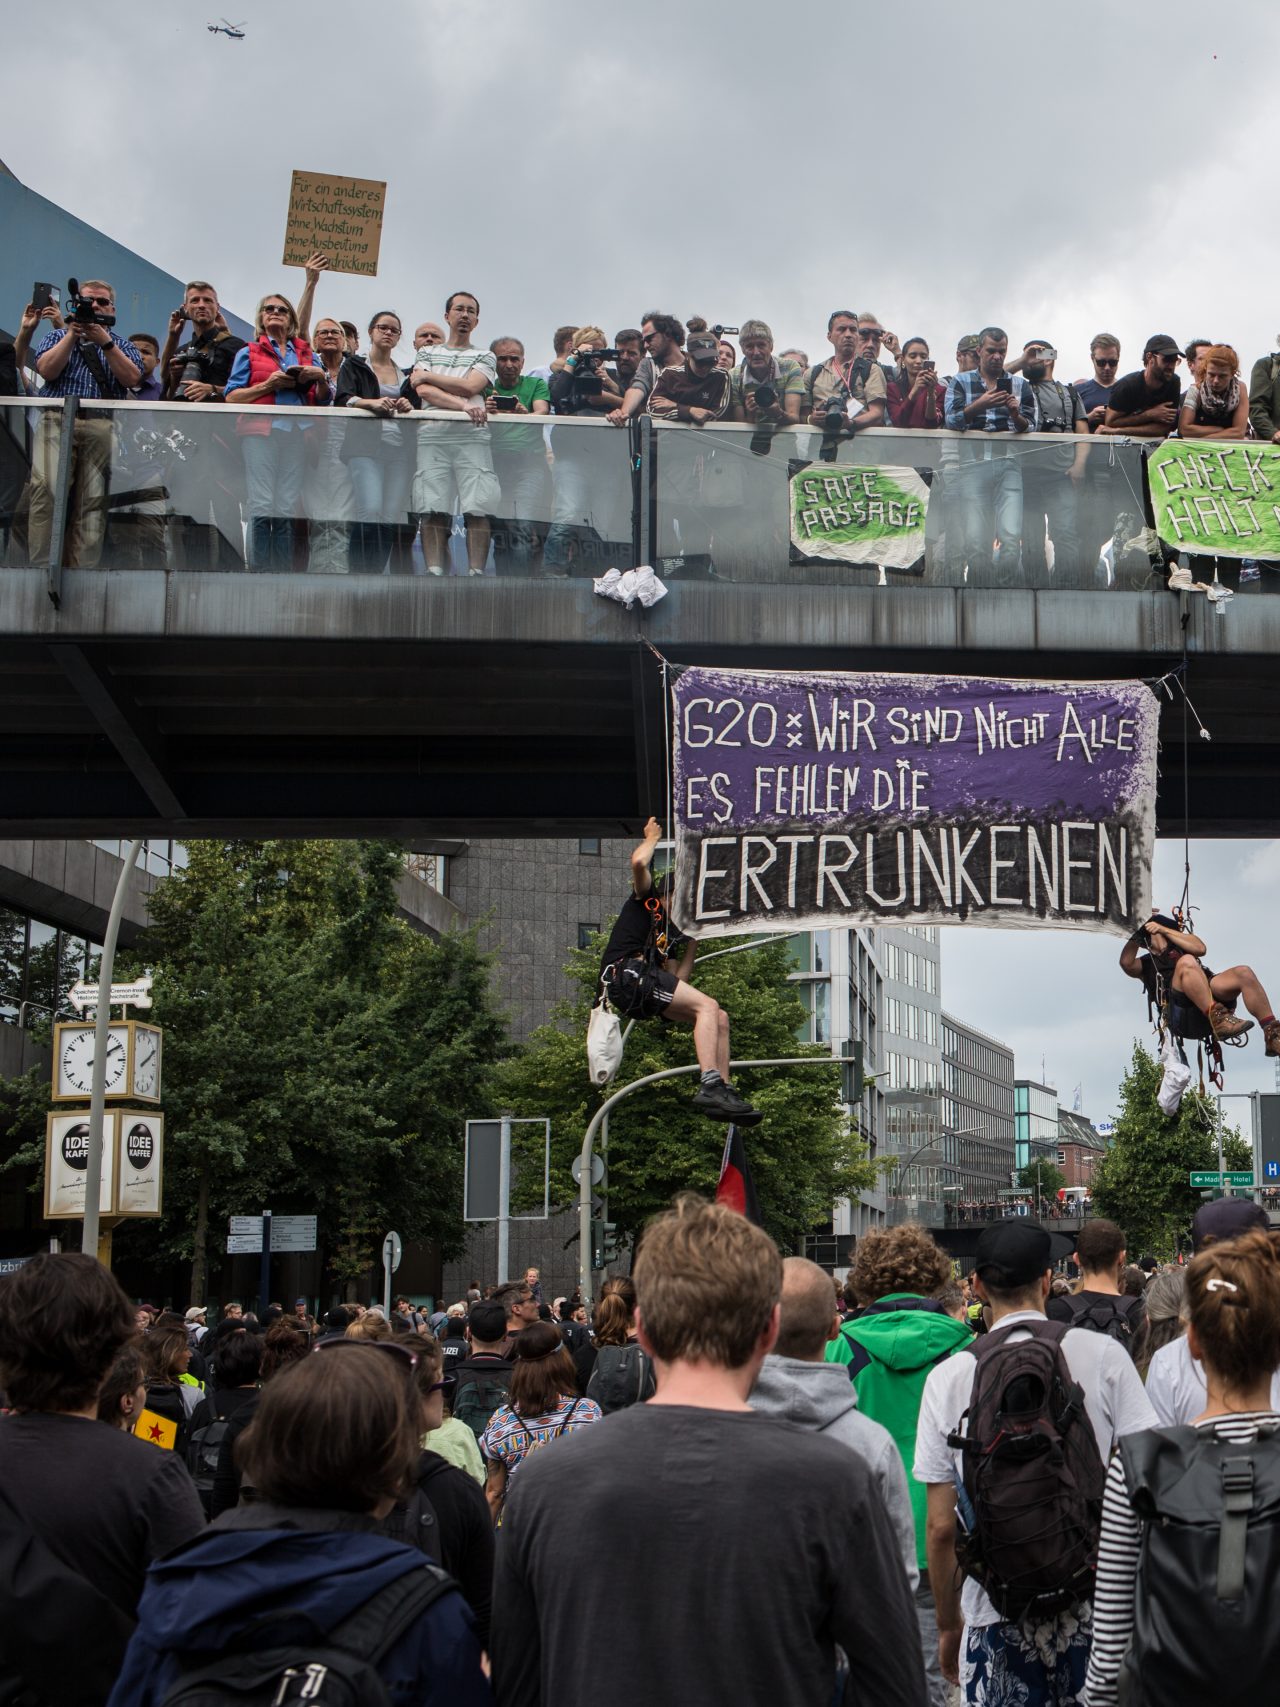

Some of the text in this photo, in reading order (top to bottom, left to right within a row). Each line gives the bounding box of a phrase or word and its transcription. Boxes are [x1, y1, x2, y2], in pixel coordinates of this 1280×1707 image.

[293, 177, 381, 202] Für ein anderes
[288, 215, 364, 236] ohne Wachstum
[286, 232, 369, 254] ohne Ausbeutung
[284, 248, 307, 263] ohne
[803, 472, 883, 505] SAFE
[801, 500, 921, 538] PASSAGE
[1166, 495, 1263, 540] HALT
[686, 771, 734, 824] ES
[755, 763, 861, 816] FEHLEN
[695, 820, 1127, 921] ERTRUNKENEN
[65, 1136, 90, 1149] IDE
[129, 1135, 152, 1149] IDEE
[65, 1150, 89, 1158] KAFF
[129, 1149, 151, 1158] KAFFEE
[1268, 1163, 1277, 1176] H
[1233, 1175, 1251, 1183] Hotel
[442, 1347, 459, 1355] LIZEI
